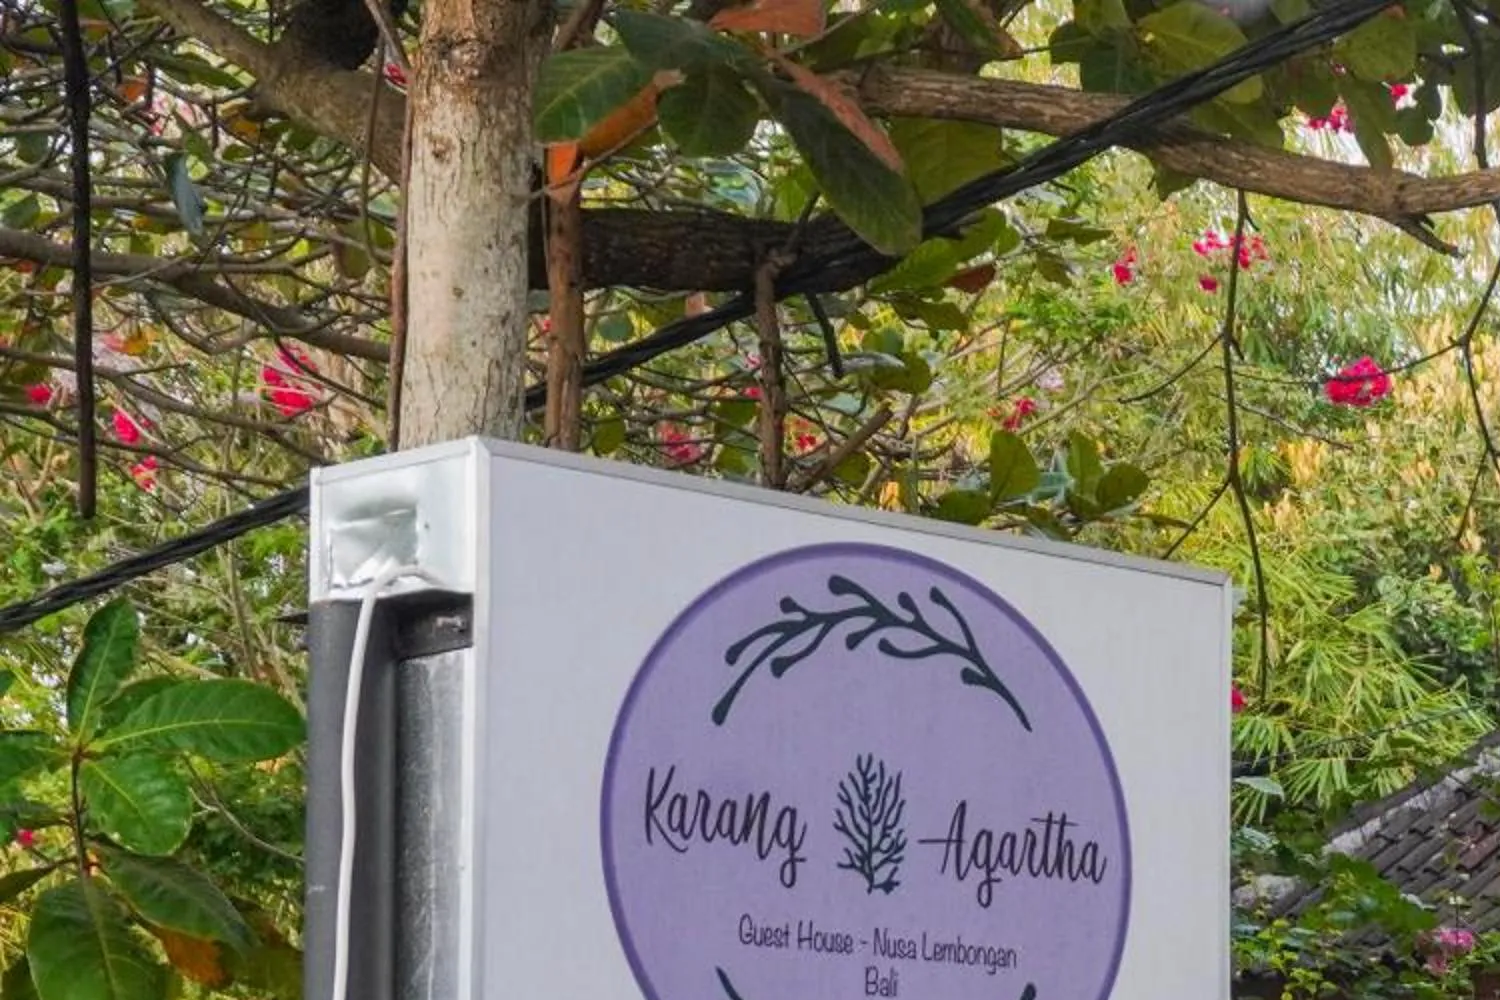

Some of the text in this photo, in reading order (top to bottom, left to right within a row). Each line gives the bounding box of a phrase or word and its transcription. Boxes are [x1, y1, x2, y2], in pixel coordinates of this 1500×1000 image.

[643, 764, 1108, 909] Karang Agartha
[738, 912, 790, 948] Guest
[796, 920, 854, 954] House
[872, 926, 917, 960] Nusa
[922, 931, 1017, 976] Lembongan
[864, 965, 898, 998] Bali
